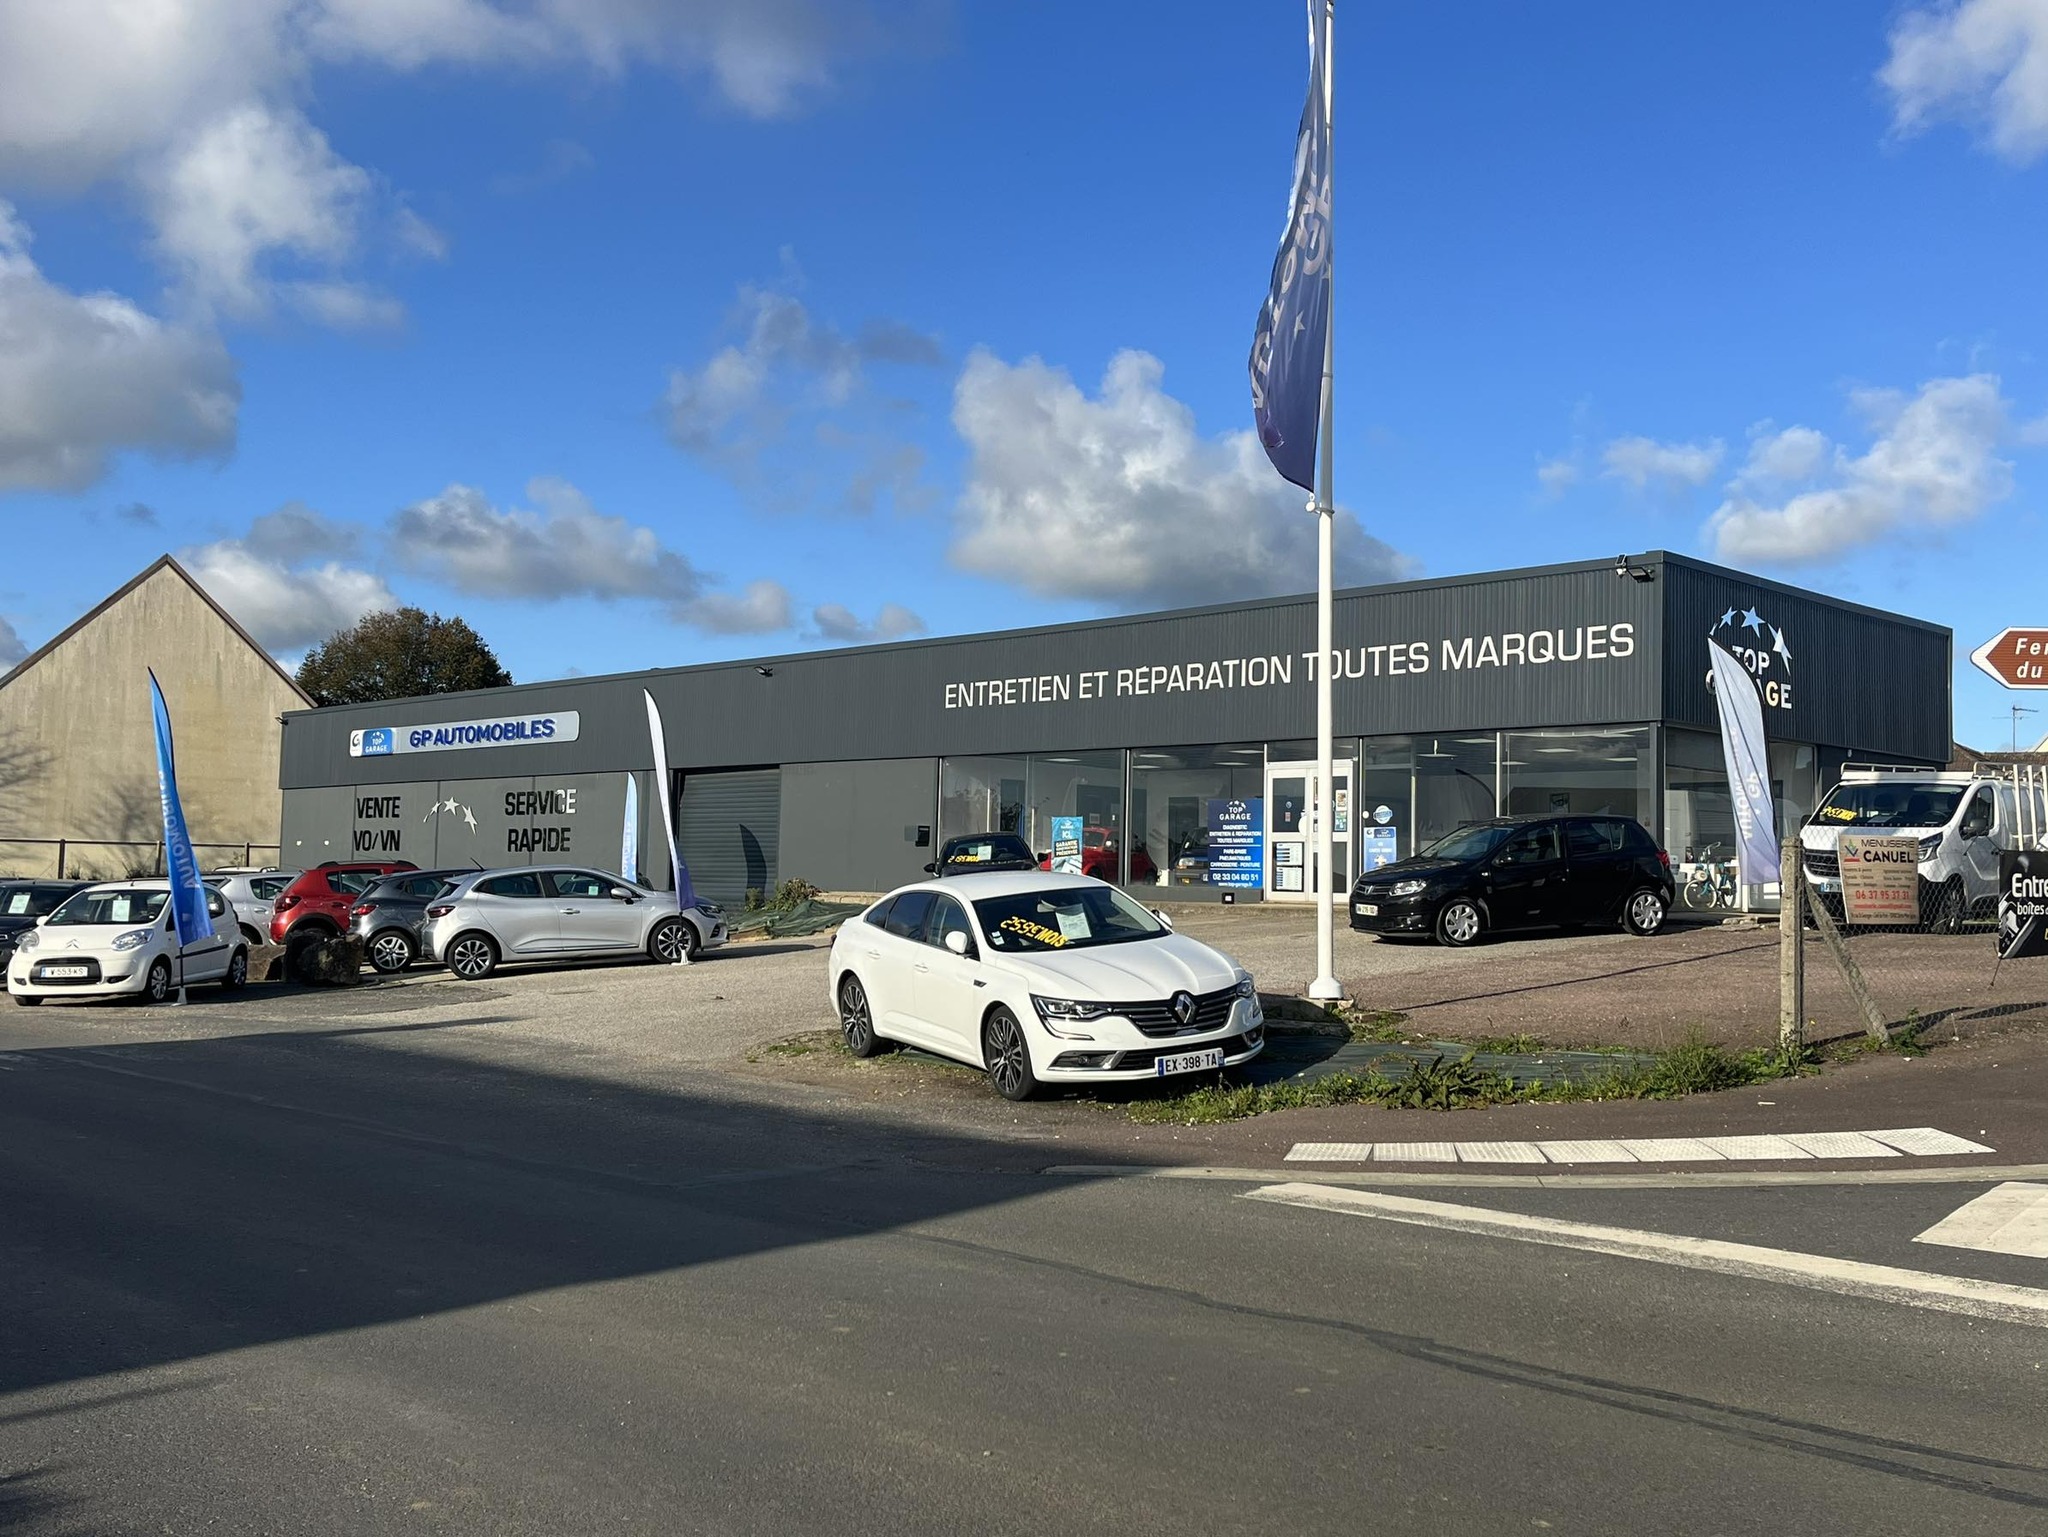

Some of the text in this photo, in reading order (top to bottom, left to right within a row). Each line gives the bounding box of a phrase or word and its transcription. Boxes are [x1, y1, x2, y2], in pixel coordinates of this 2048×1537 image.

[945, 674, 1070, 709] ENTRETIEN
[1079, 671, 1108, 699] ET
[1117, 654, 1291, 696] RÉPARATION
[1442, 623, 1634, 671] MARQUES
[2016, 661, 2043, 679] du
[372, 738, 384, 746] TOP
[410, 719, 556, 748] GP AUTOMOBILES
[365, 745, 389, 753] GARAGE
[357, 797, 401, 818] VENTE
[505, 789, 577, 815] SERVICE
[507, 827, 571, 852] RAPIDE
[1861, 839, 1915, 848] MENUISERIE
[1863, 850, 1914, 863] CANUEL
[1250, 873, 1259, 881] 51
[1855, 890, 1866, 900] 06
[1868, 890, 1878, 900] 37
[1880, 890, 1889, 900] 95
[1891, 890, 1900, 900] 37
[1165, 1053, 1217, 1072] EX-398-TA
